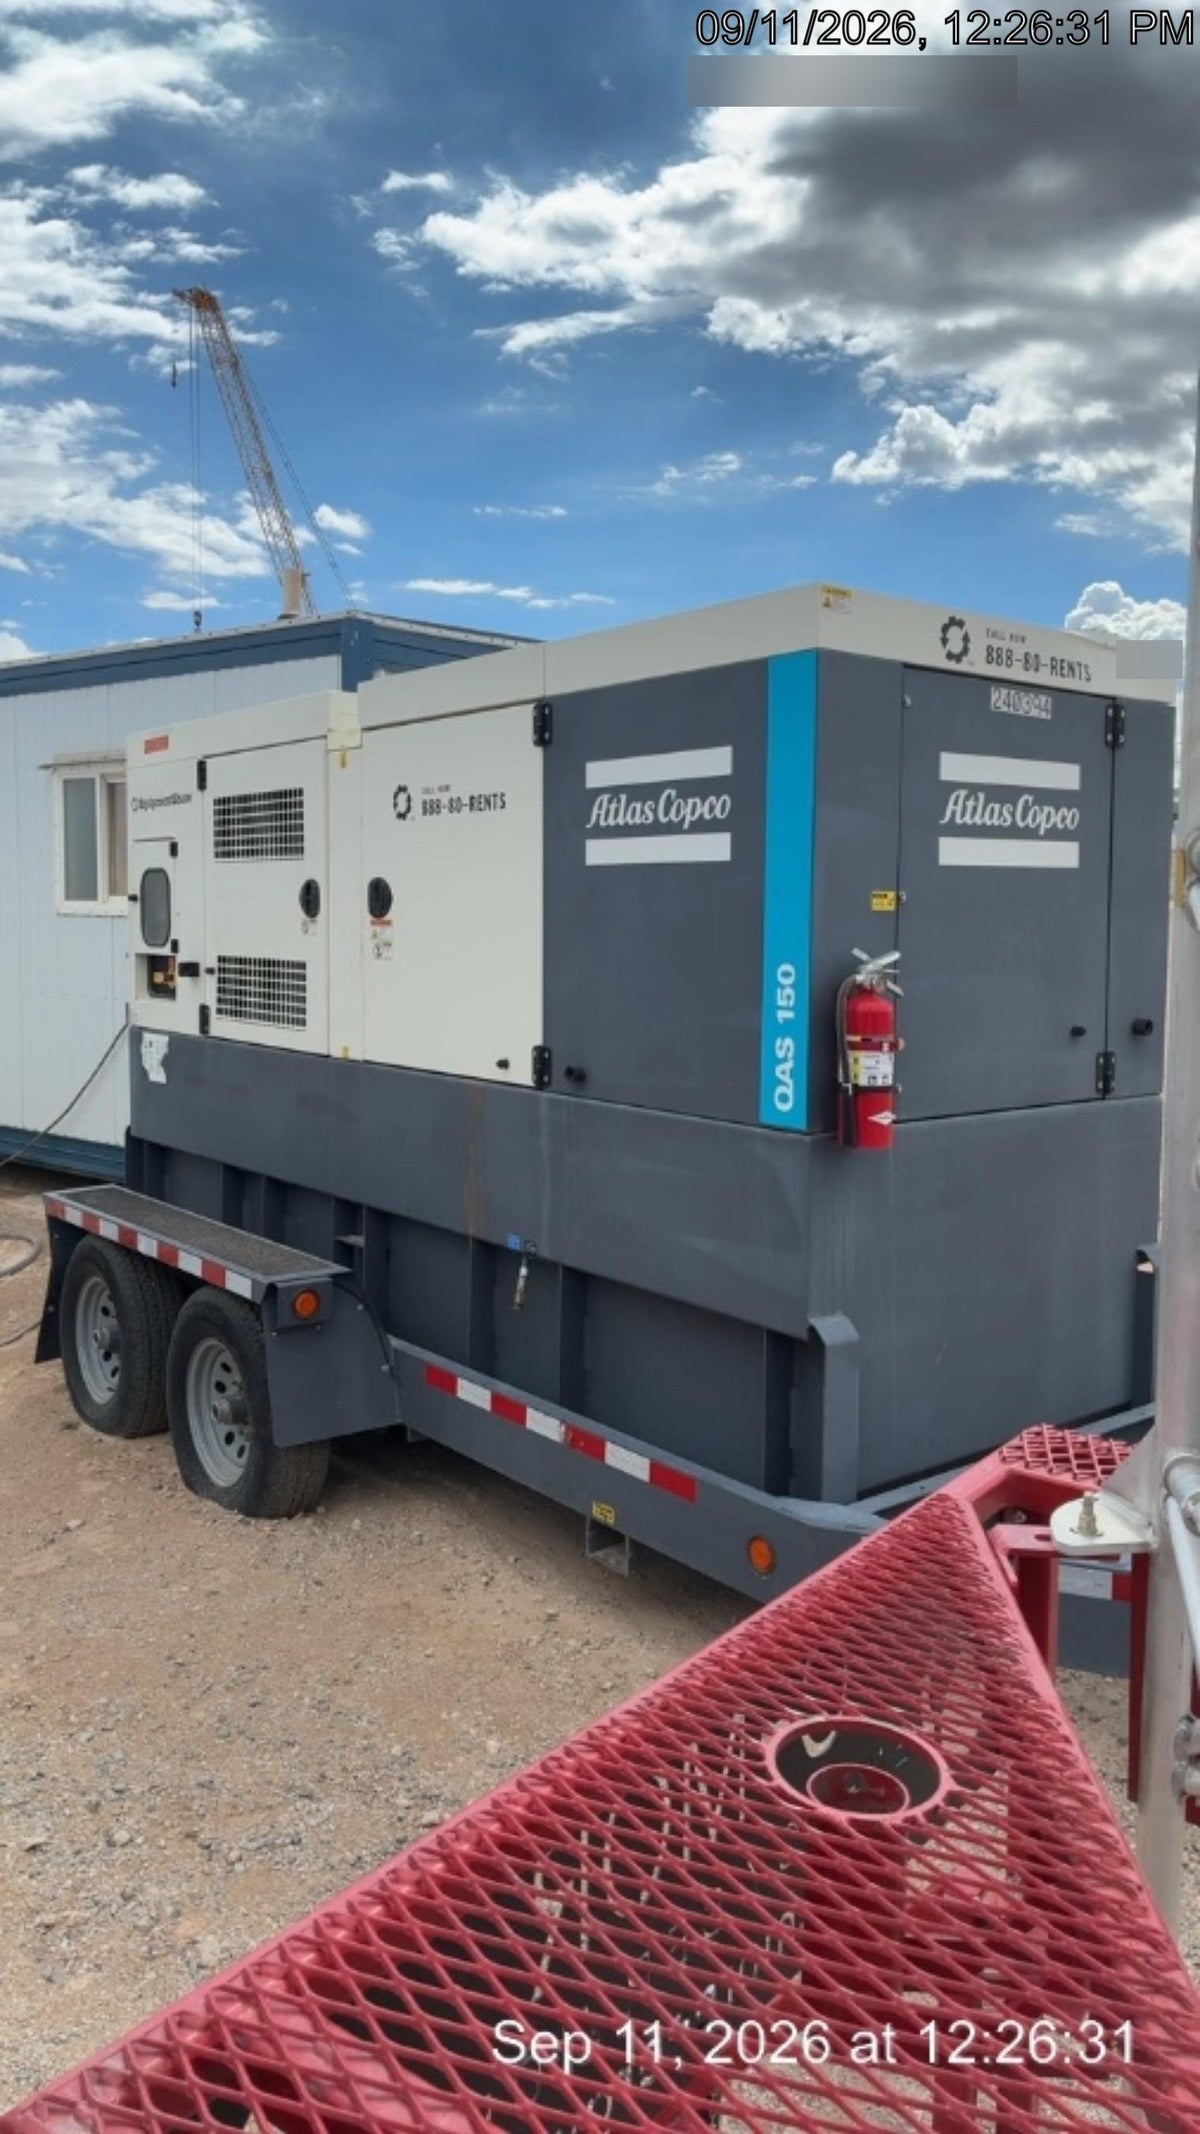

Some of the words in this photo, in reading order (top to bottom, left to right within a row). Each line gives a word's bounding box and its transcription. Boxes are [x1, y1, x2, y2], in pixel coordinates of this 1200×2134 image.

[985, 644, 1092, 682] 888-80-RENTS
[585, 793, 656, 828] Atlas
[656, 788, 731, 830] Copco
[938, 789, 1014, 827] Atlas
[1014, 793, 1080, 835] Copco
[776, 963, 796, 1025] 150
[774, 1035, 795, 1113] QAS
